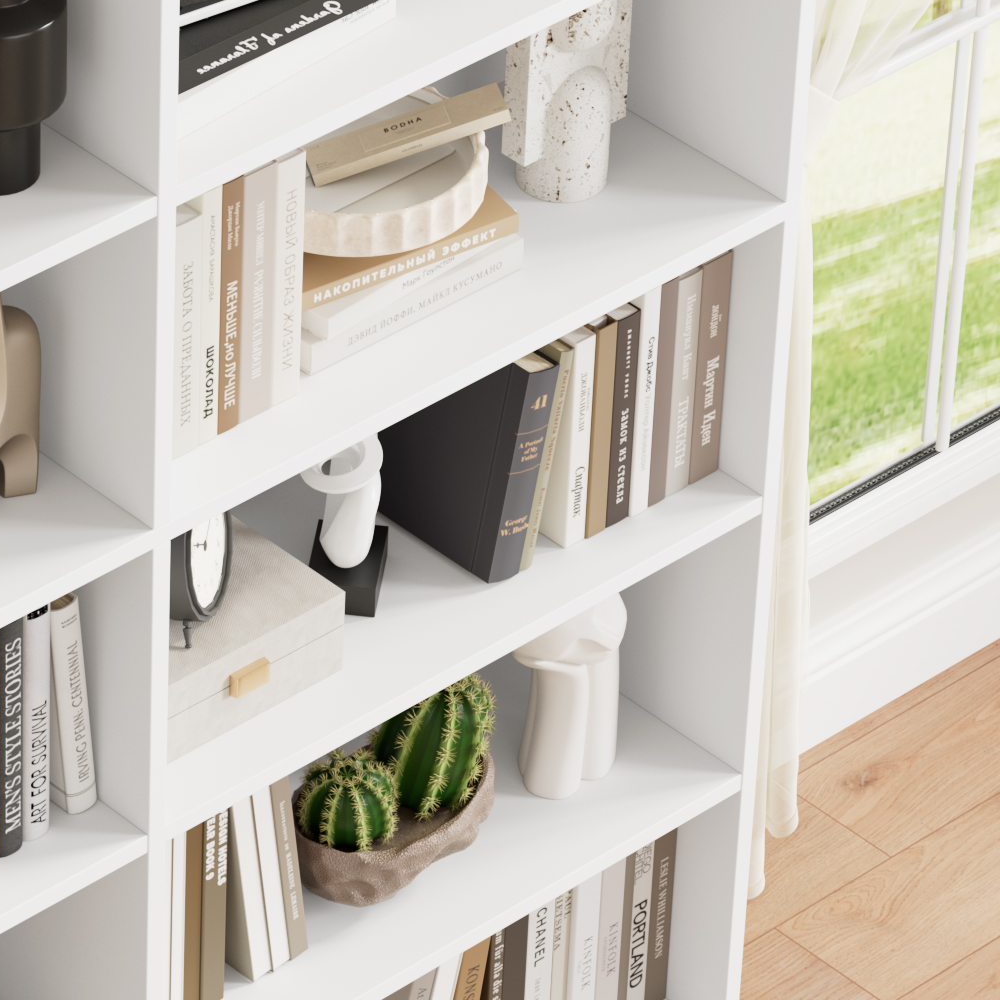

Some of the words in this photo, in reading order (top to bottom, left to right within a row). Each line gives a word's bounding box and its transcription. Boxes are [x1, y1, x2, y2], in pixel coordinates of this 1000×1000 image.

[382, 116, 423, 134] BODHA
[285, 188, 298, 251] НОВЫЙ
[283, 253, 296, 306] ОБРАЗ
[313, 247, 438, 304] НАКОПИТЕЛЬНЫЙ
[441, 228, 498, 257] ЭФФЕКТ
[401, 273, 421, 291] Марк
[422, 256, 456, 278] Гоулстон
[183, 261, 194, 318] ЗАБОТА
[347, 325, 379, 347] ДЭВИД
[418, 288, 451, 310] МАЙКЛ
[453, 260, 504, 292] КУСУМАНО
[183, 320, 192, 332] О
[281, 310, 295, 371] ЖИЗНИ
[683, 293, 697, 351] Иммануил
[648, 336, 656, 360] Стив
[682, 352, 693, 381] Кант
[180, 334, 193, 427] ПРЕДАННЫХ
[203, 345, 215, 420] ШОКОЛАД
[223, 359, 237, 411] ЛУЧШЕ
[560, 369, 570, 398] Puerto
[645, 361, 654, 393] Джобс
[703, 355, 721, 409] Мартин
[530, 394, 548, 411] 41
[552, 400, 563, 436] Vallarta
[674, 396, 690, 469] ТРАКТАТЫ
[700, 408, 717, 447] Иден
[545, 436, 556, 471] Squeeze
[571, 466, 586, 519] Спартак
[500, 529, 512, 537] W.
[505, 515, 528, 527] George
[4, 636, 22, 716] STORIES
[67, 640, 83, 708] CENTENNIAL
[31, 700, 47, 764] SURVIVAL
[74, 708, 87, 741] PENN:
[4, 714, 22, 782] STYLE
[78, 742, 90, 784] IRVING
[30, 766, 47, 798] FOR
[30, 802, 47, 824] ART
[206, 815, 216, 841] EAR
[218, 808, 228, 846] ESIGN
[205, 840, 215, 873] BOOK
[205, 872, 215, 881] 9
[217, 845, 228, 887] HOTELS
[659, 856, 669, 890] LESLIE
[534, 907, 548, 968] CHANEL
[606, 921, 619, 977] KINFOLK
[629, 899, 648, 989] PORTLAND
[581, 936, 593, 991] KINFOLK
